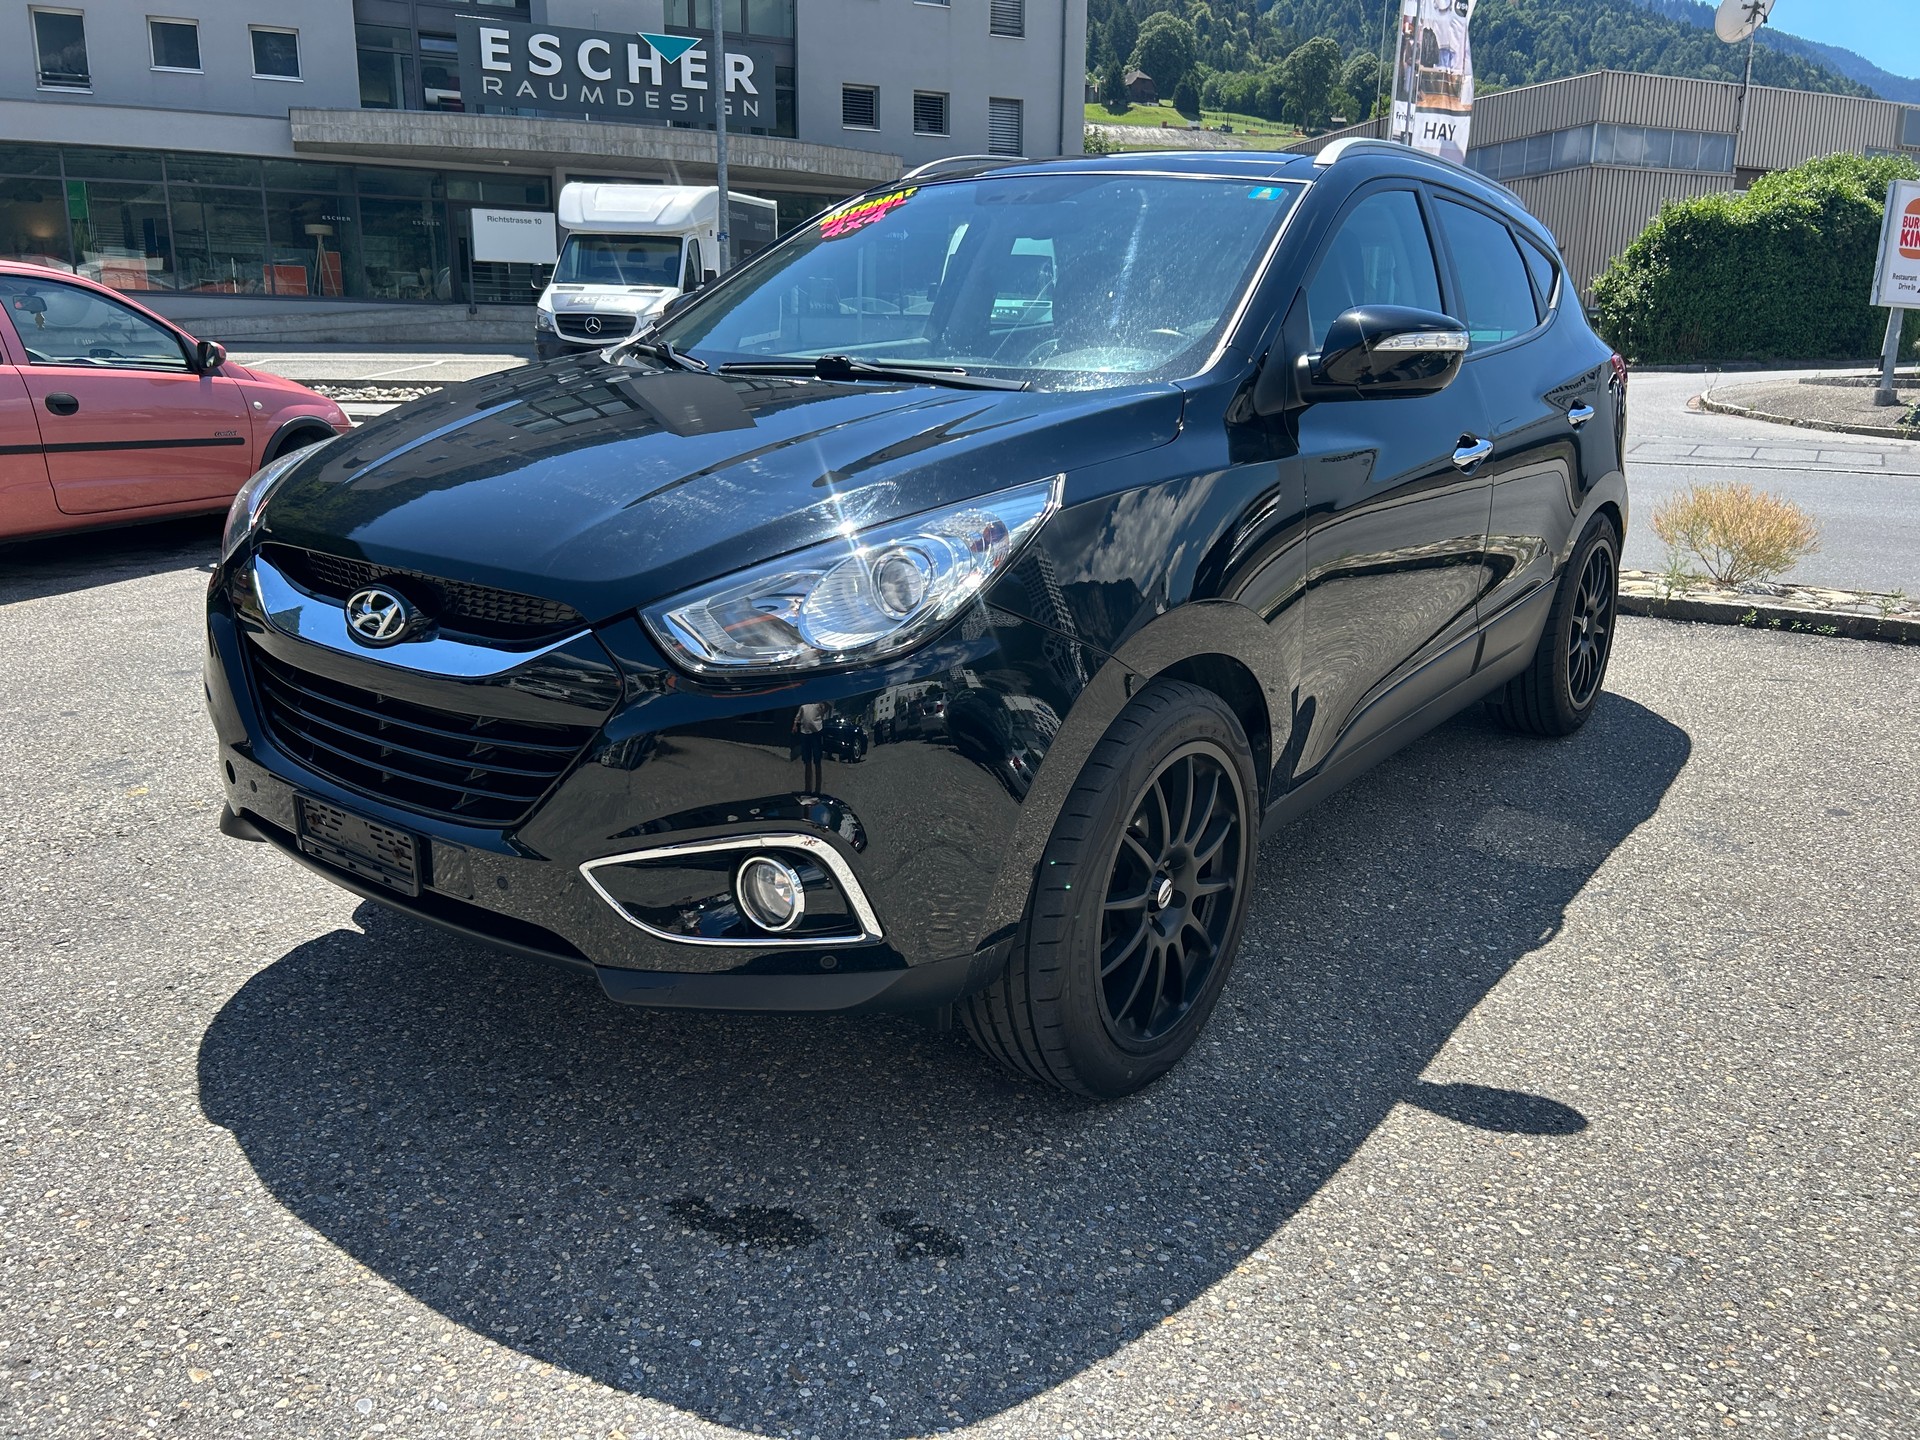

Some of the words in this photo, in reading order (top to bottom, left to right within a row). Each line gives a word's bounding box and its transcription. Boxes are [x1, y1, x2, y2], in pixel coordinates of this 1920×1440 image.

[479, 27, 759, 95] ESCHER
[482, 76, 759, 117] RAUMDESIGN
[1423, 121, 1457, 141] HAY
[486, 215, 533, 225] Richtstrasse
[1902, 215, 1920, 229] BUR
[1892, 273, 1917, 281] Restaurant
